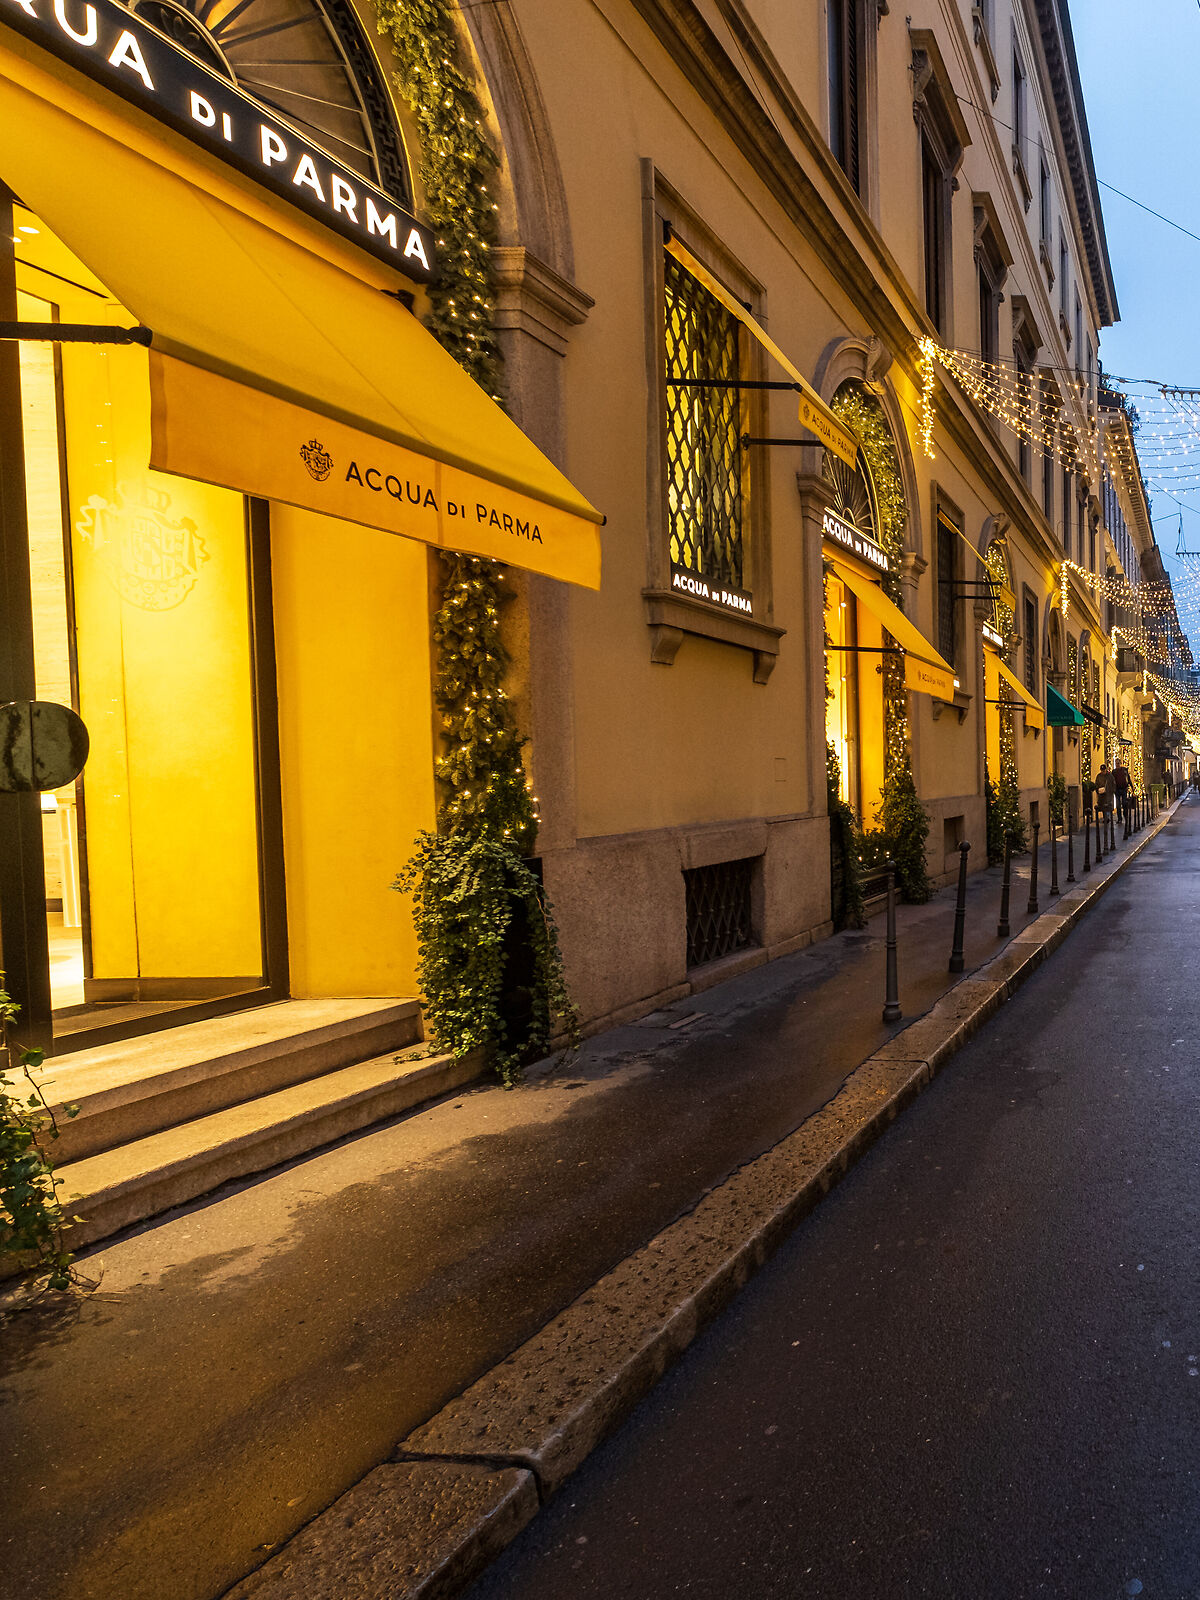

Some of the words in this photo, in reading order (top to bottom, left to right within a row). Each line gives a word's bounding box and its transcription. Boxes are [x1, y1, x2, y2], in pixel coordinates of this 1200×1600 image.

[13, 0, 155, 91] UA
[189, 90, 232, 142] DI
[260, 124, 430, 270] PARMA
[345, 461, 439, 512] ACQUA
[448, 501, 466, 518] DI
[476, 504, 543, 544] PARMA
[823, 514, 853, 548] ACQUA
[862, 541, 889, 571] PARMA
[673, 573, 709, 598] ACQUA
[721, 590, 753, 613] PARMA
